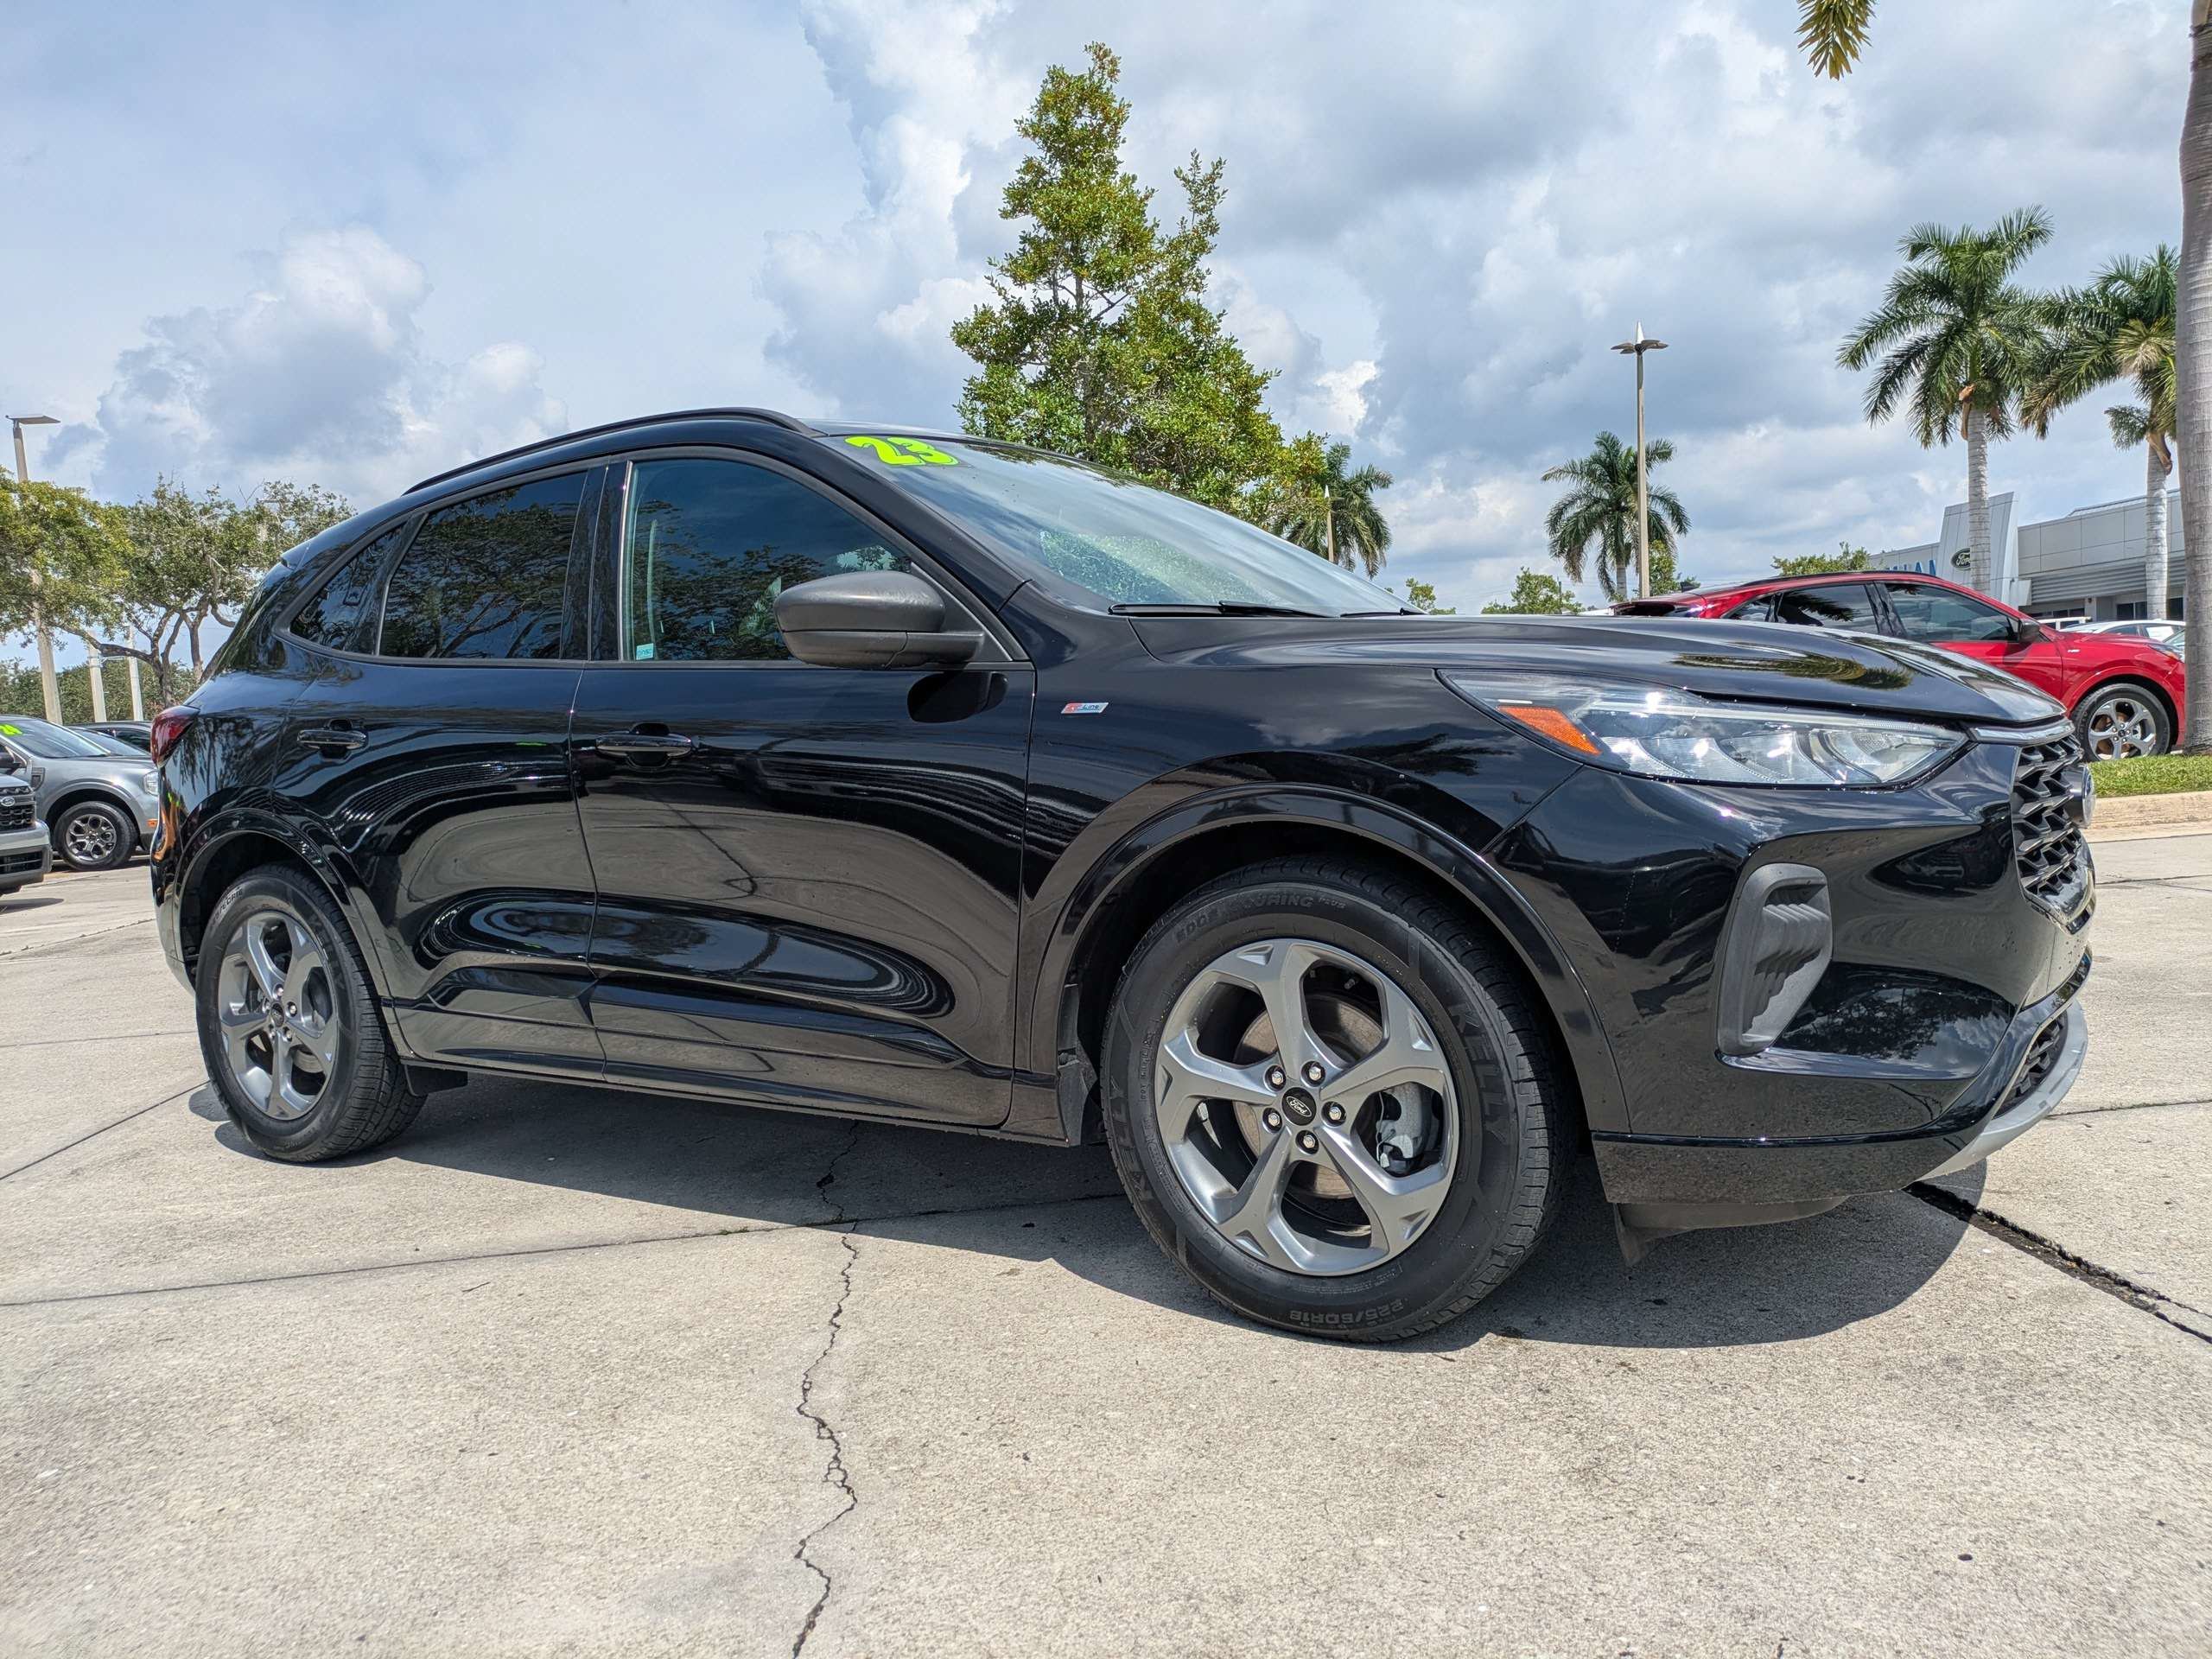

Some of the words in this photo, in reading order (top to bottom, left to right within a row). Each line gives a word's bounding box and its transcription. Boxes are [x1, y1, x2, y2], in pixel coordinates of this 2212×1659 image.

[845, 435, 959, 466] 23
[1290, 1099, 1307, 1115] Ford
[1447, 1001, 1509, 1146] KELLY
[1109, 1075, 1154, 1202] KELLY
